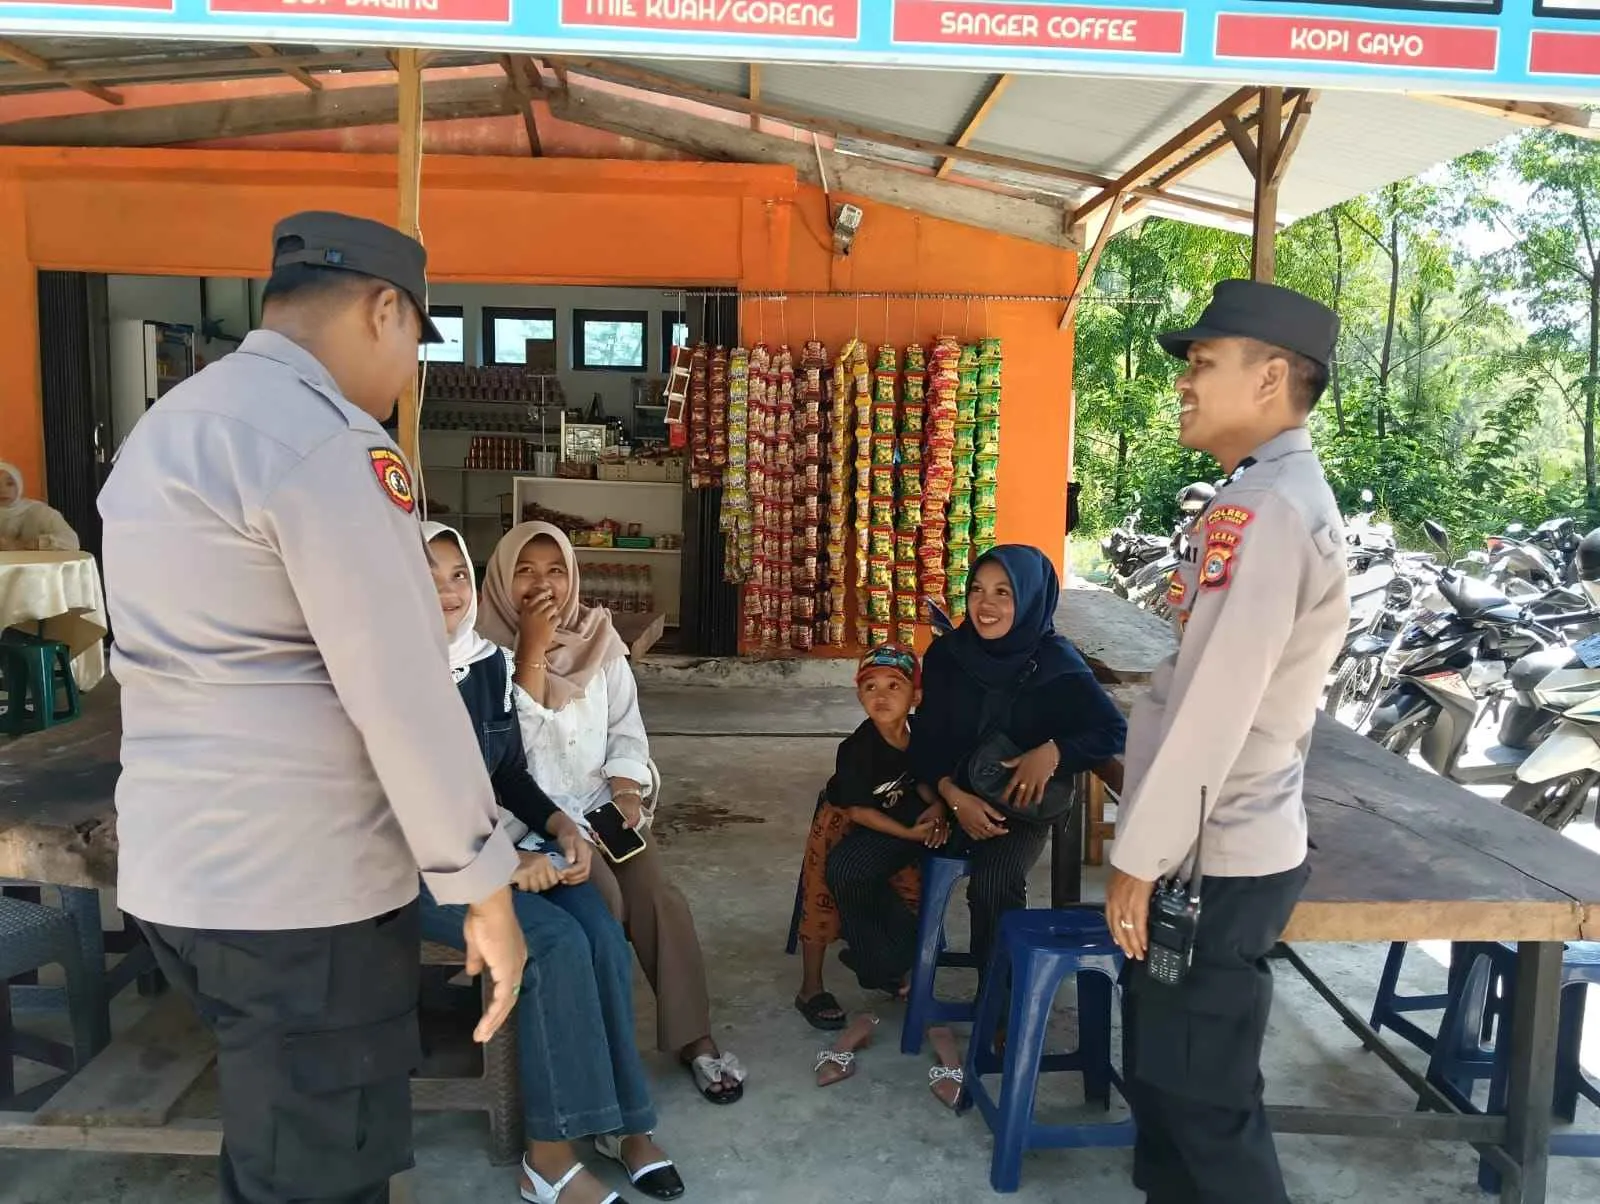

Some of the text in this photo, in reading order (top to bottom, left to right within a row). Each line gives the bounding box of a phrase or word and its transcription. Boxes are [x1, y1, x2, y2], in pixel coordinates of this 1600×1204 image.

[586, 0, 835, 27] MIE KUAH/GORENG
[940, 11, 1138, 41] SANGER COFFEE
[1290, 27, 1424, 57] KOPI GAYO
[1208, 509, 1248, 521] POLRES
